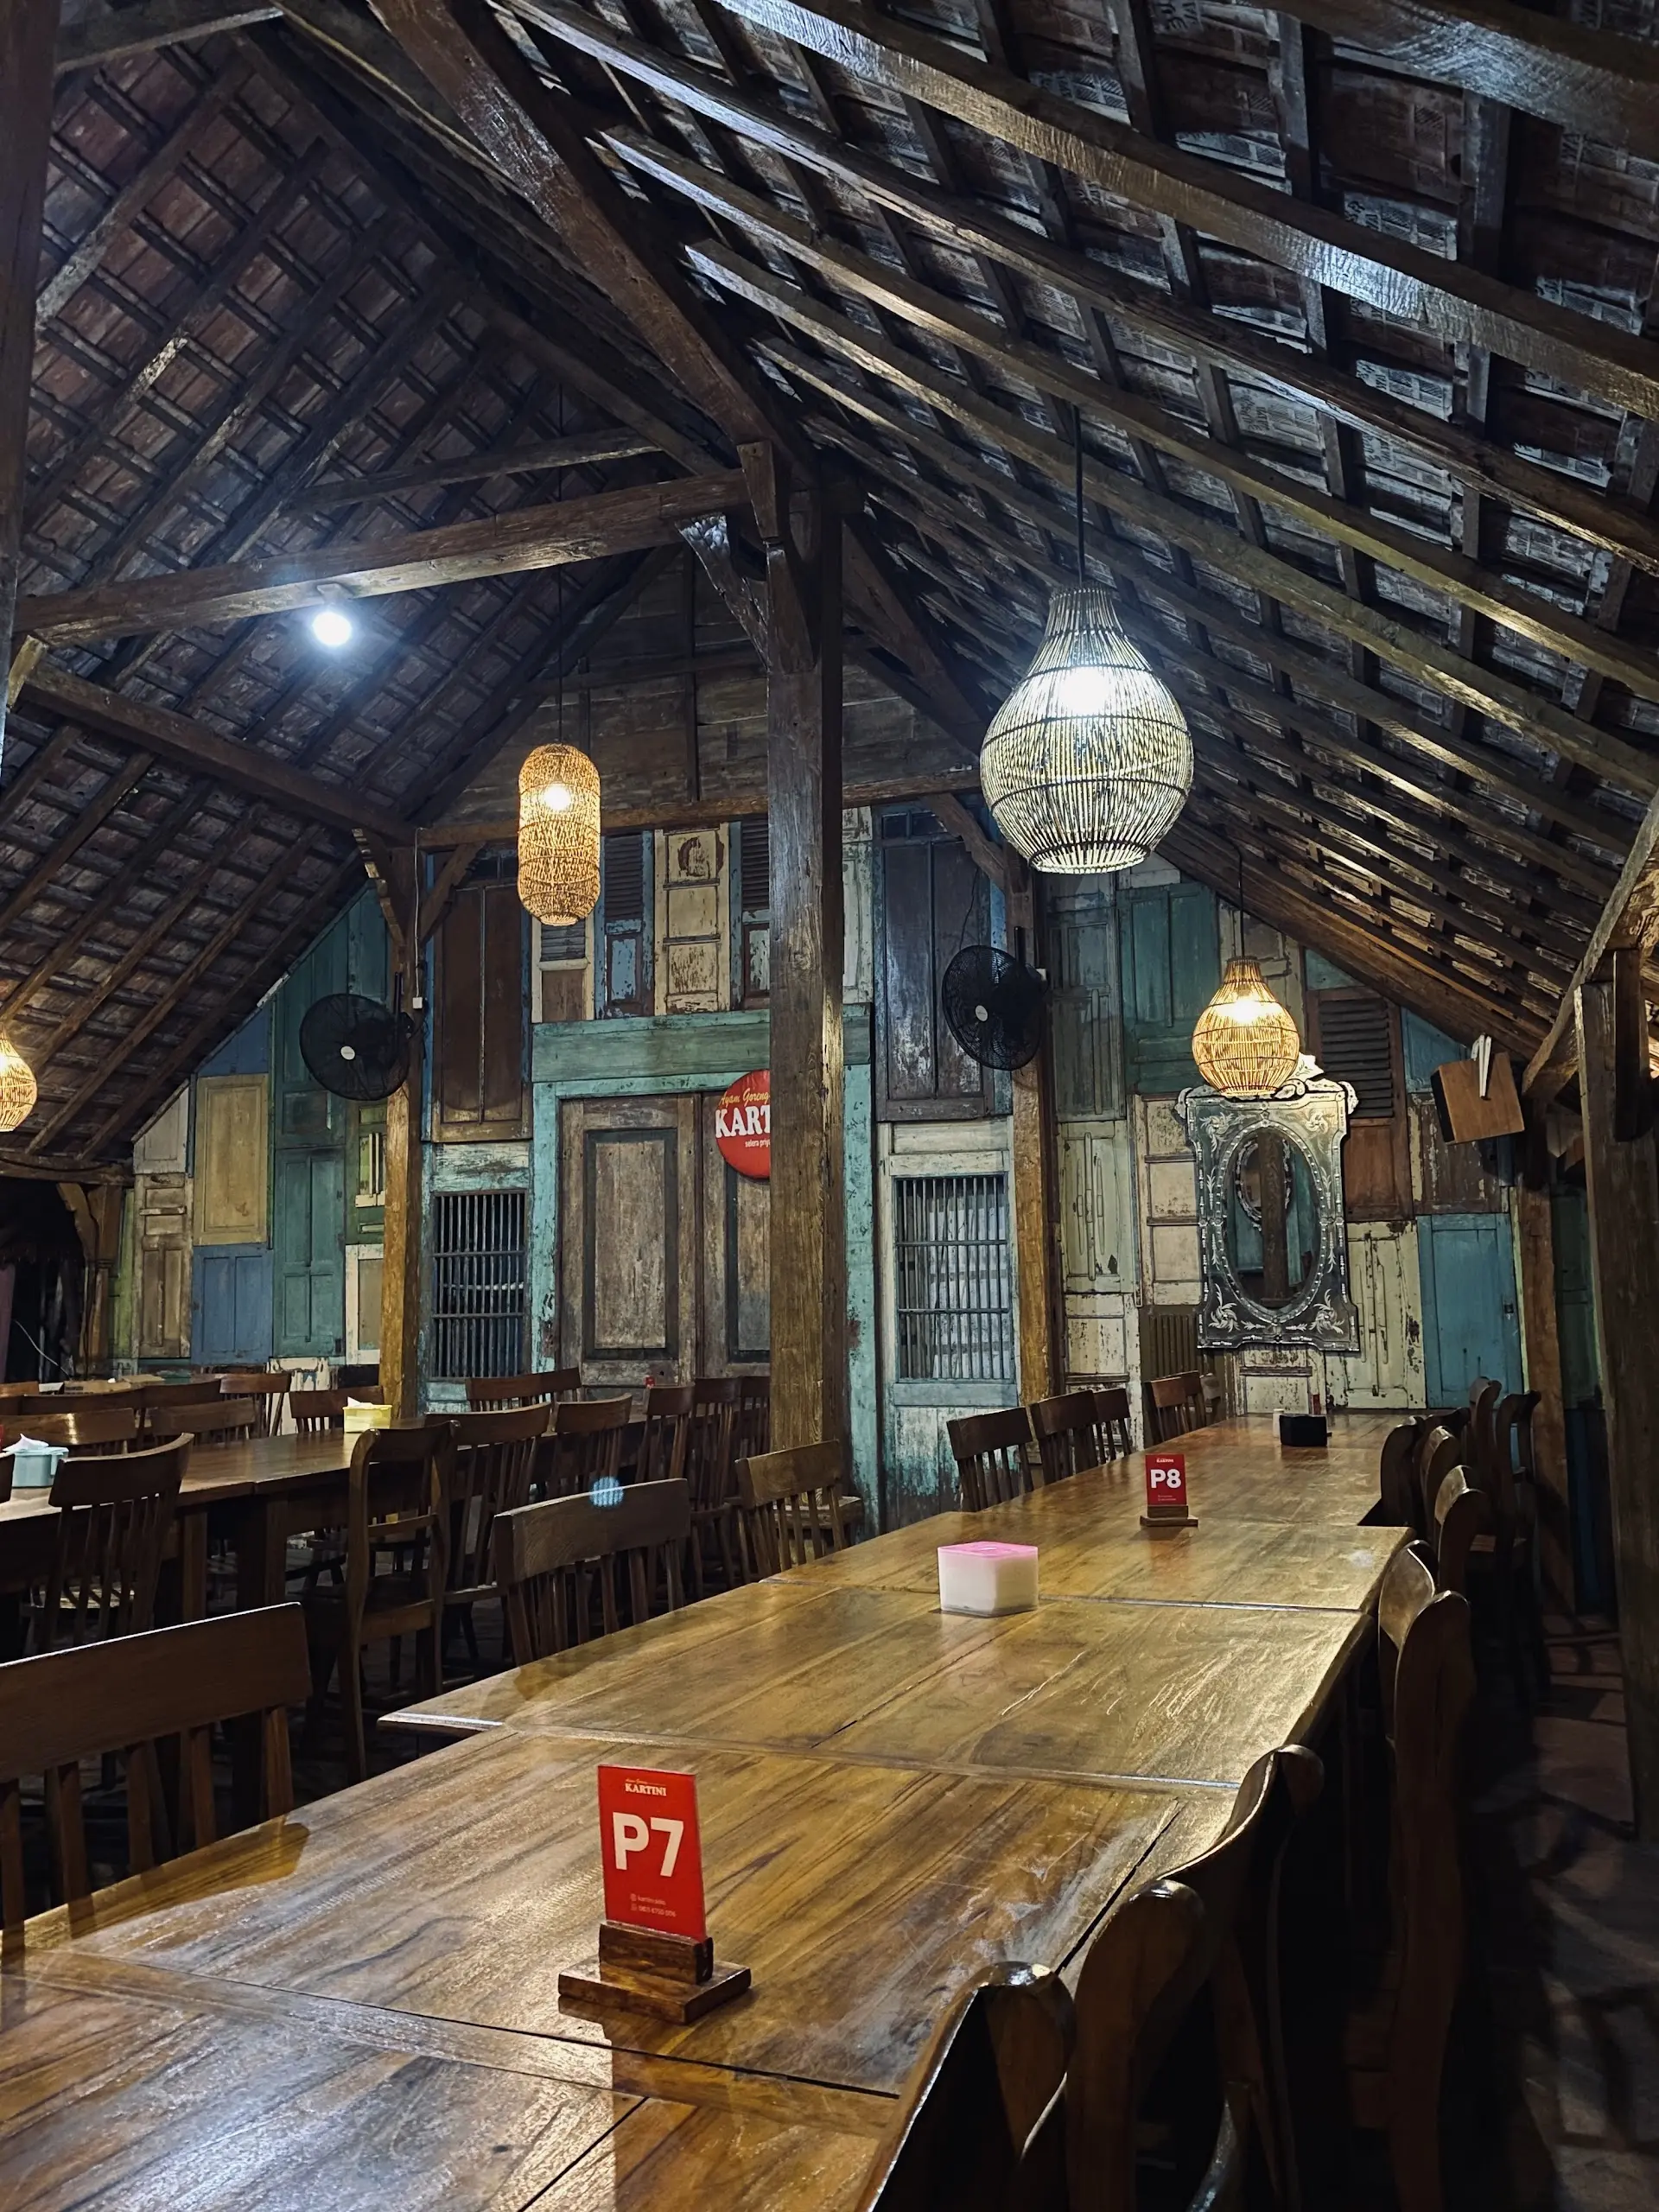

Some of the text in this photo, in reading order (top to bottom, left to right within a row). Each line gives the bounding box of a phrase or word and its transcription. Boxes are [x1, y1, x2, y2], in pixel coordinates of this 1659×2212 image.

[719, 1091, 741, 1108] Ayam
[1150, 1468, 1182, 1489] P8
[625, 1783, 667, 1796] KARTINI
[612, 1811, 684, 1877] P7
